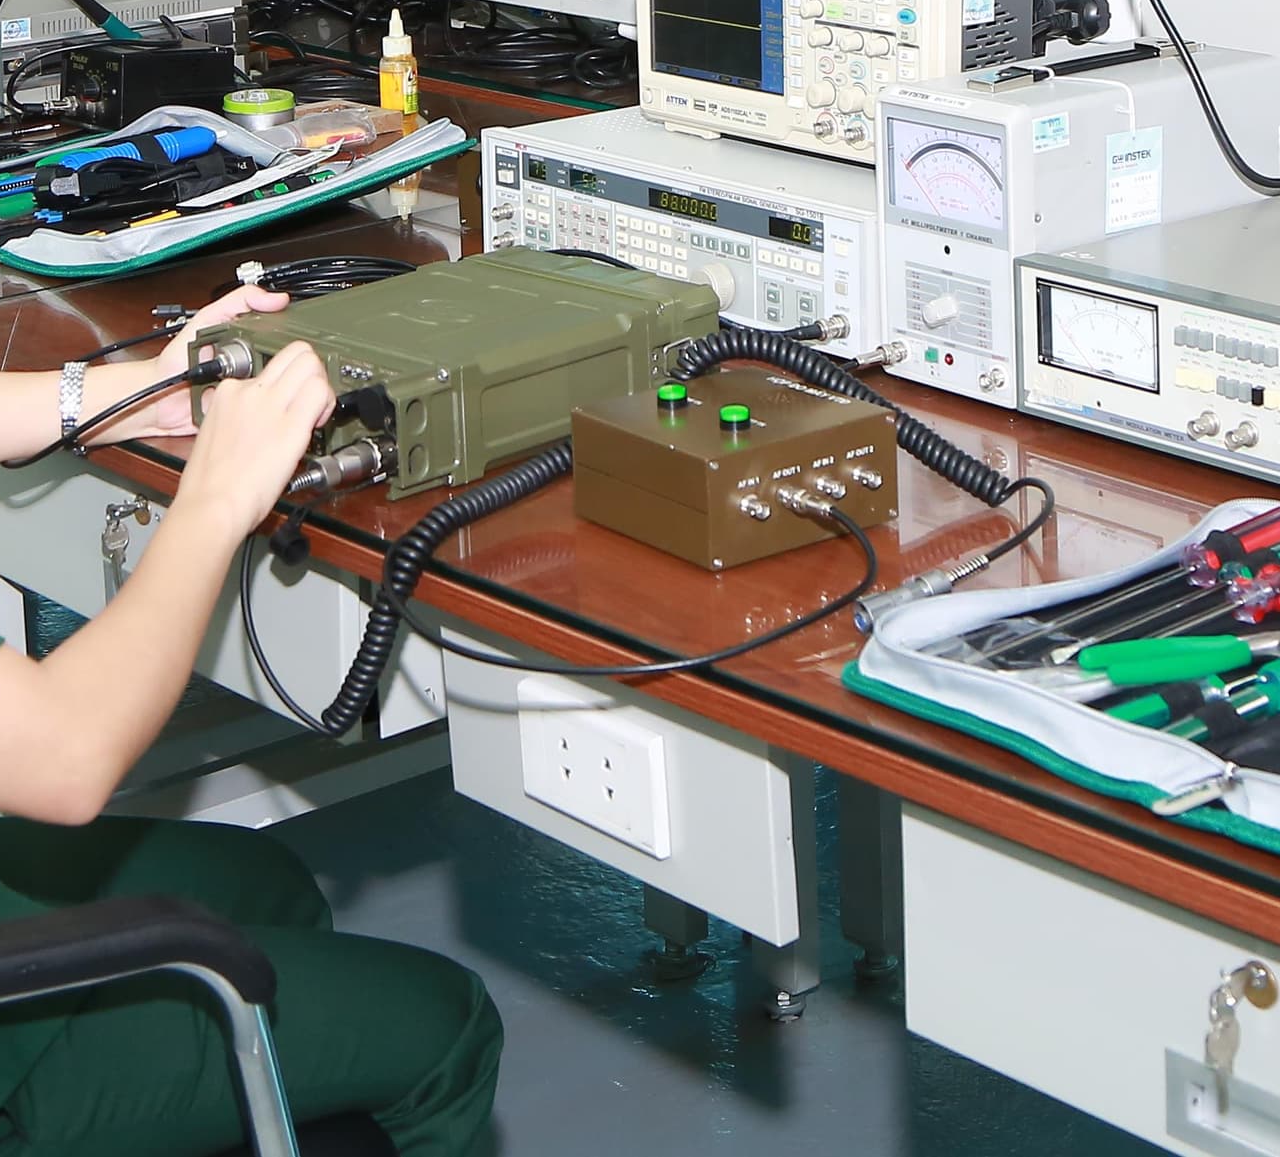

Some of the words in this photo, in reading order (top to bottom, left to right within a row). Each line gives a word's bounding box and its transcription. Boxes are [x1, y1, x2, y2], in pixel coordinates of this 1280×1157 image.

[666, 95, 688, 106] ATTEN
[910, 219, 958, 236] MILLIVOLTMETER
[966, 233, 993, 244] CHANNEL
[1164, 432, 1185, 441] METER
[782, 467, 796, 476] OUT
